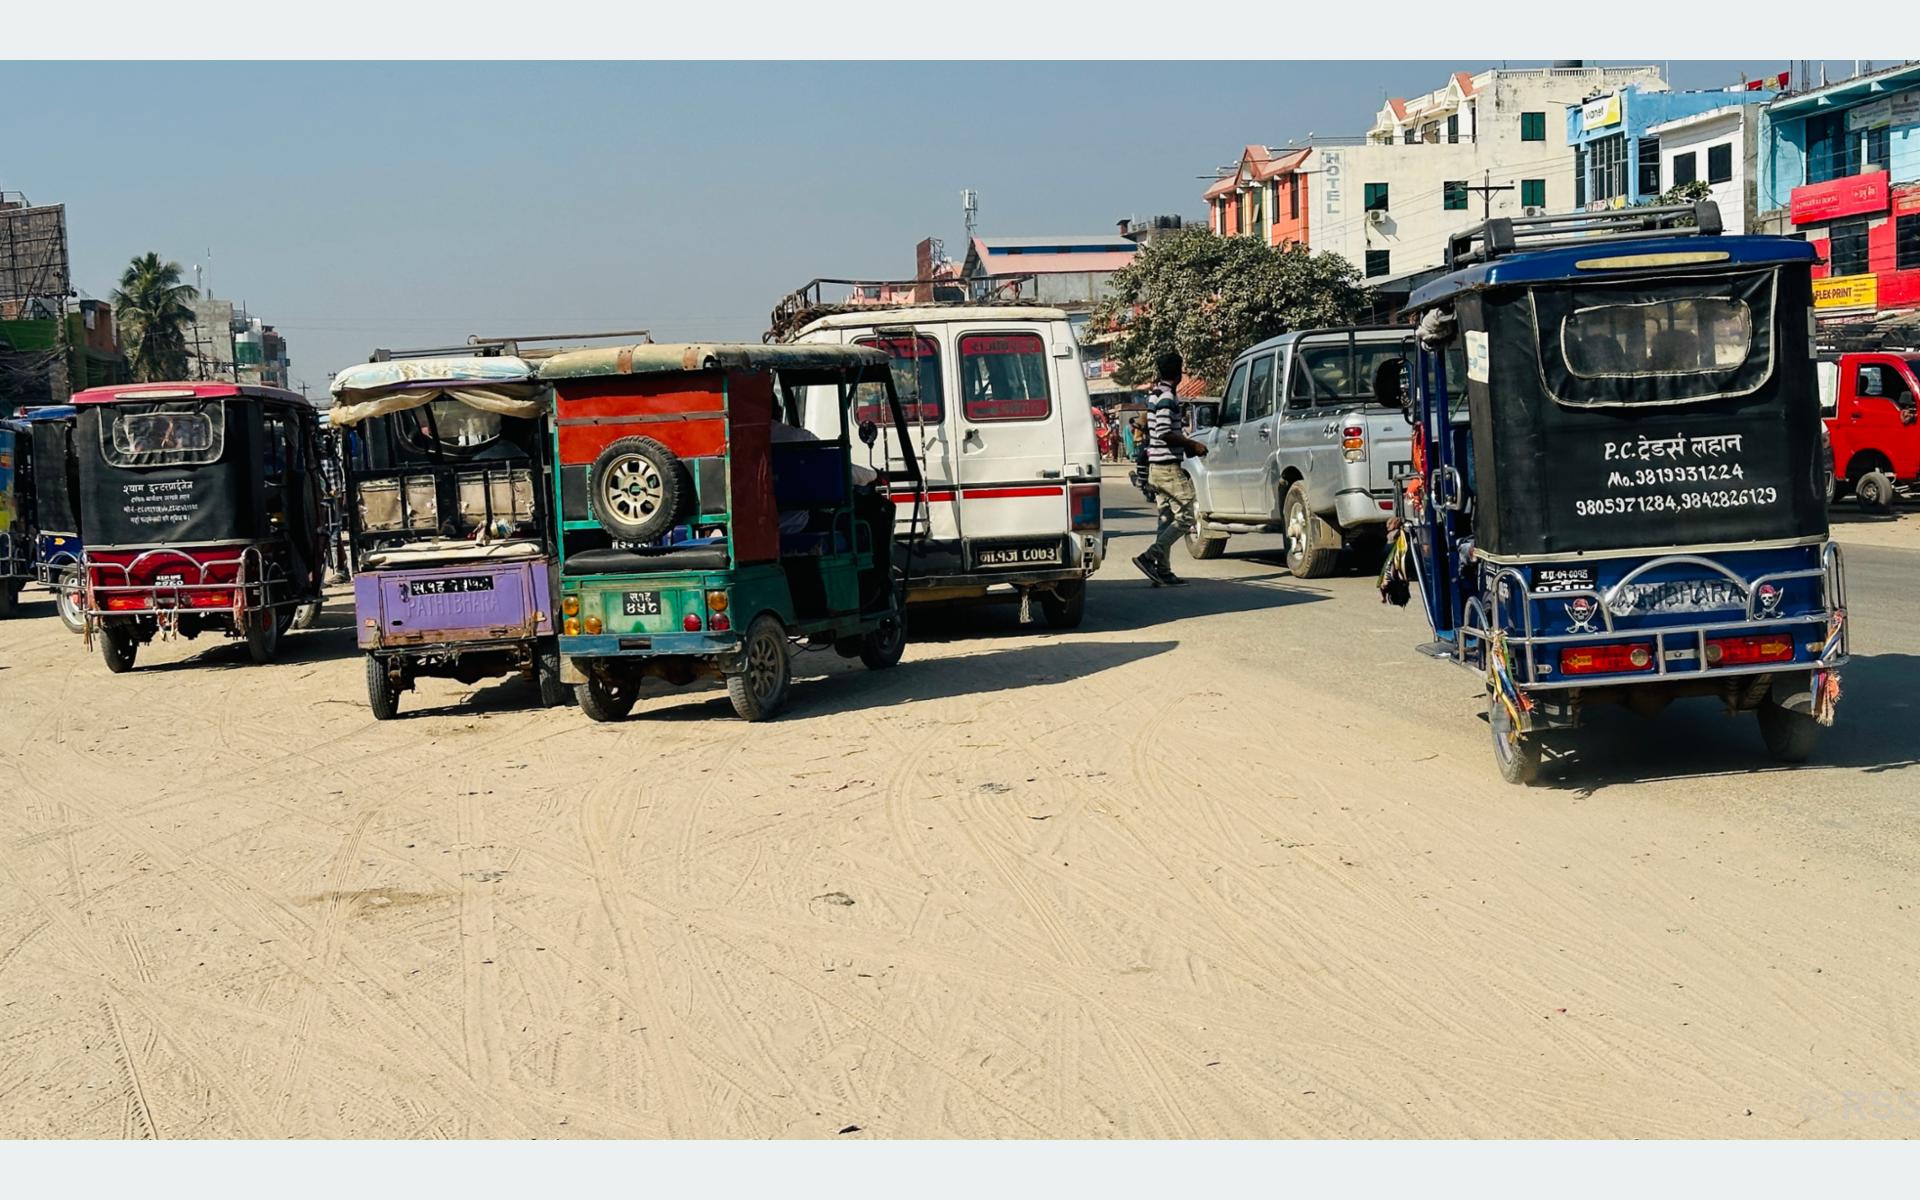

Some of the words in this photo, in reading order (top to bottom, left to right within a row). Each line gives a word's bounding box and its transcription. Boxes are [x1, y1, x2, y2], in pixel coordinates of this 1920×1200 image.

[1326, 153, 1341, 214] HOTEL
[1690, 434, 1743, 457] लहान
[1607, 463, 1744, 488] Mo.9819931224
[1022, 547, 1055, 561] ८०७३
[627, 602, 657, 614] ४५८
